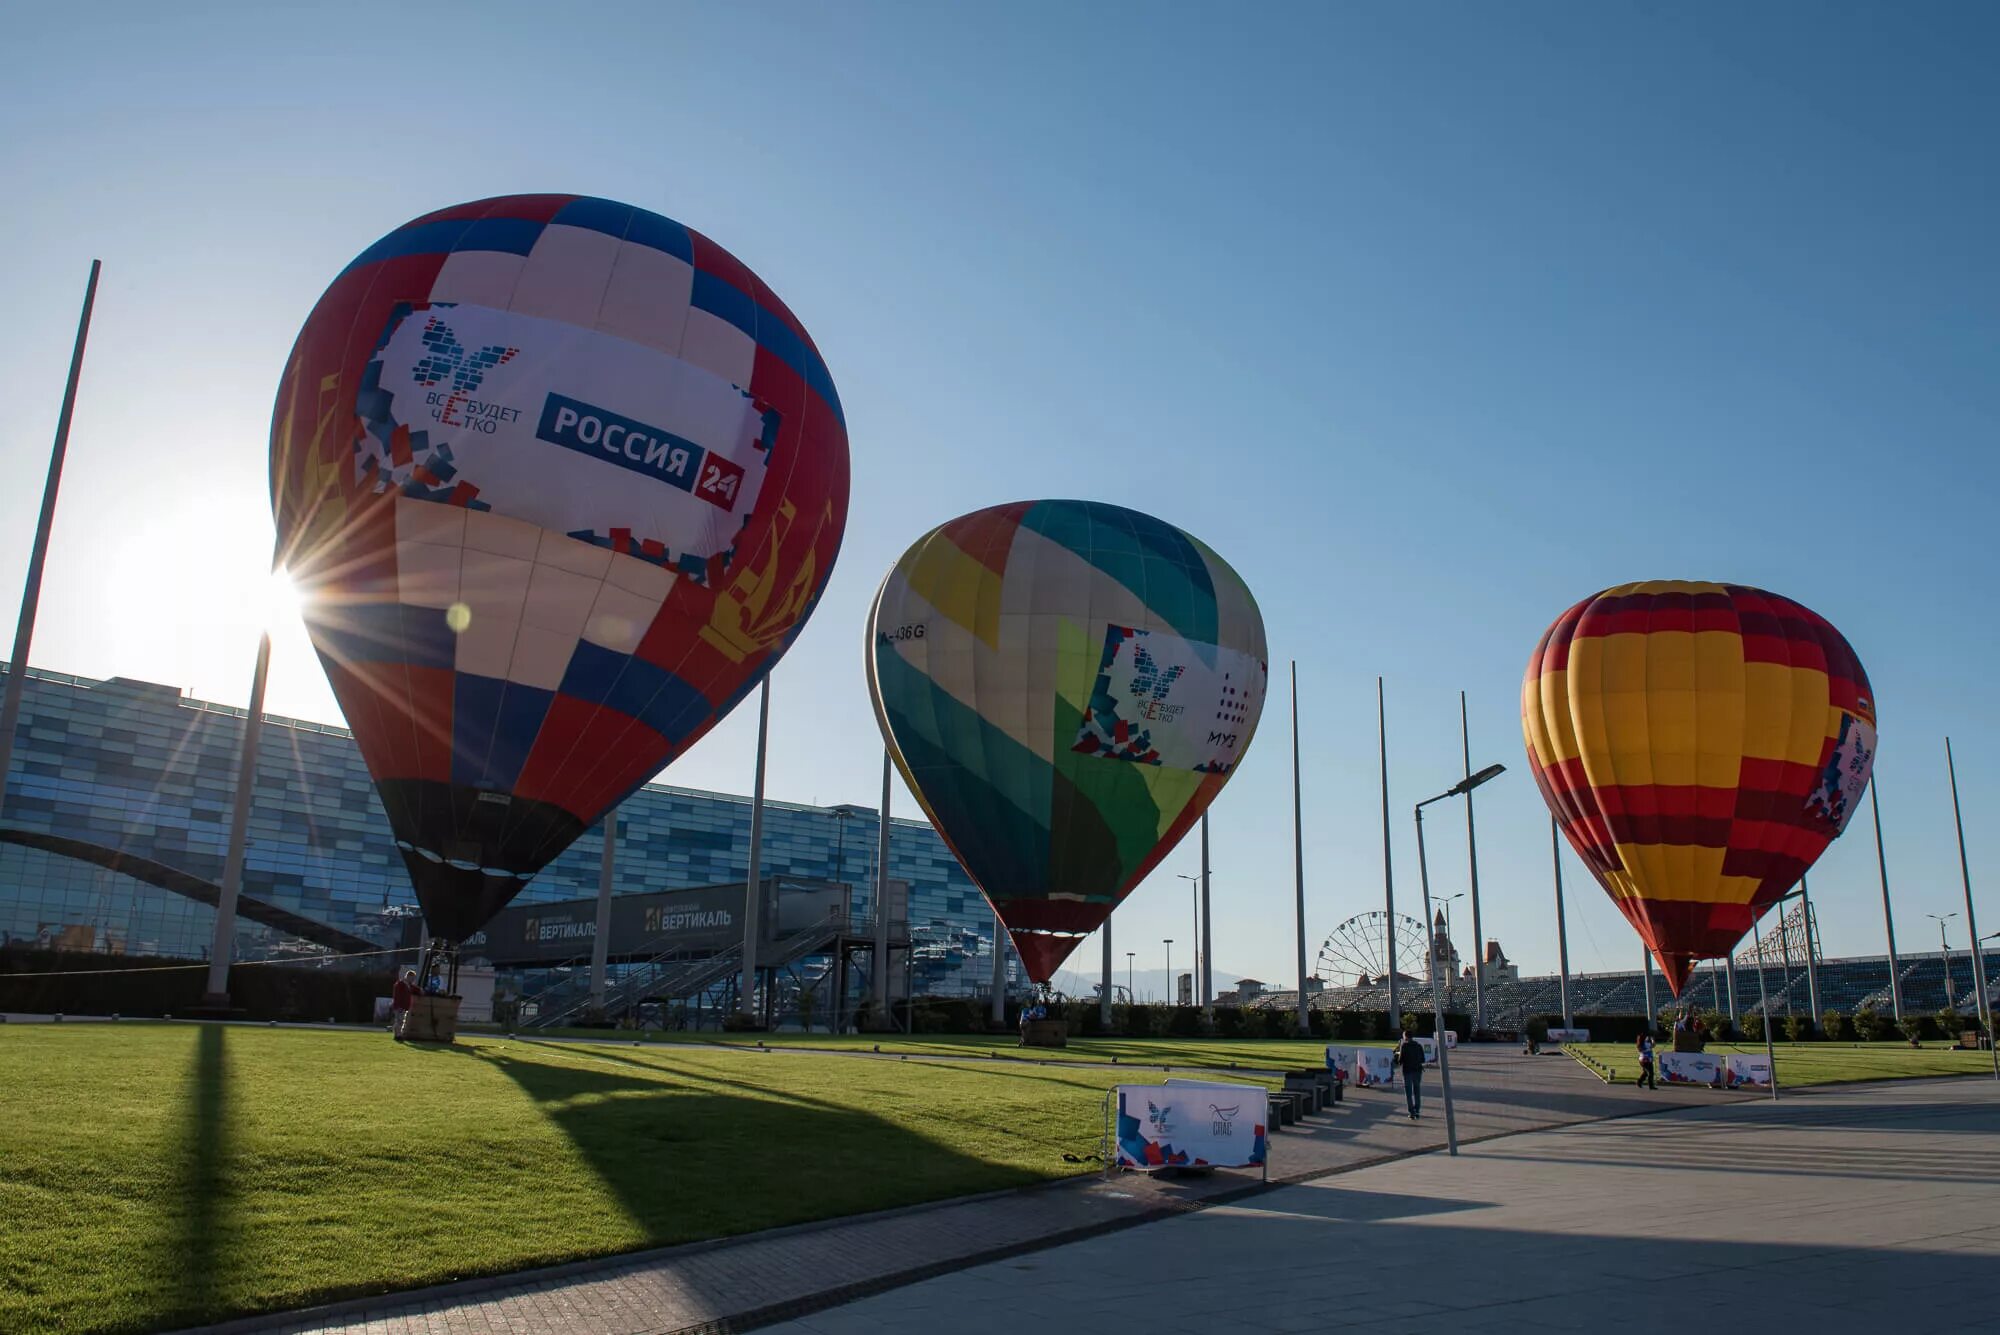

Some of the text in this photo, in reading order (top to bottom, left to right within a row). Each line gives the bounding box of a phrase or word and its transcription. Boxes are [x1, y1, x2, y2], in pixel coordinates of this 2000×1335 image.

[467, 400, 522, 423] БУДЕТ
[554, 406, 737, 501] РОССИЯ 24
[1207, 731, 1237, 748] МУЗ
[662, 910, 731, 930] ВЕРТИКАЛЬ
